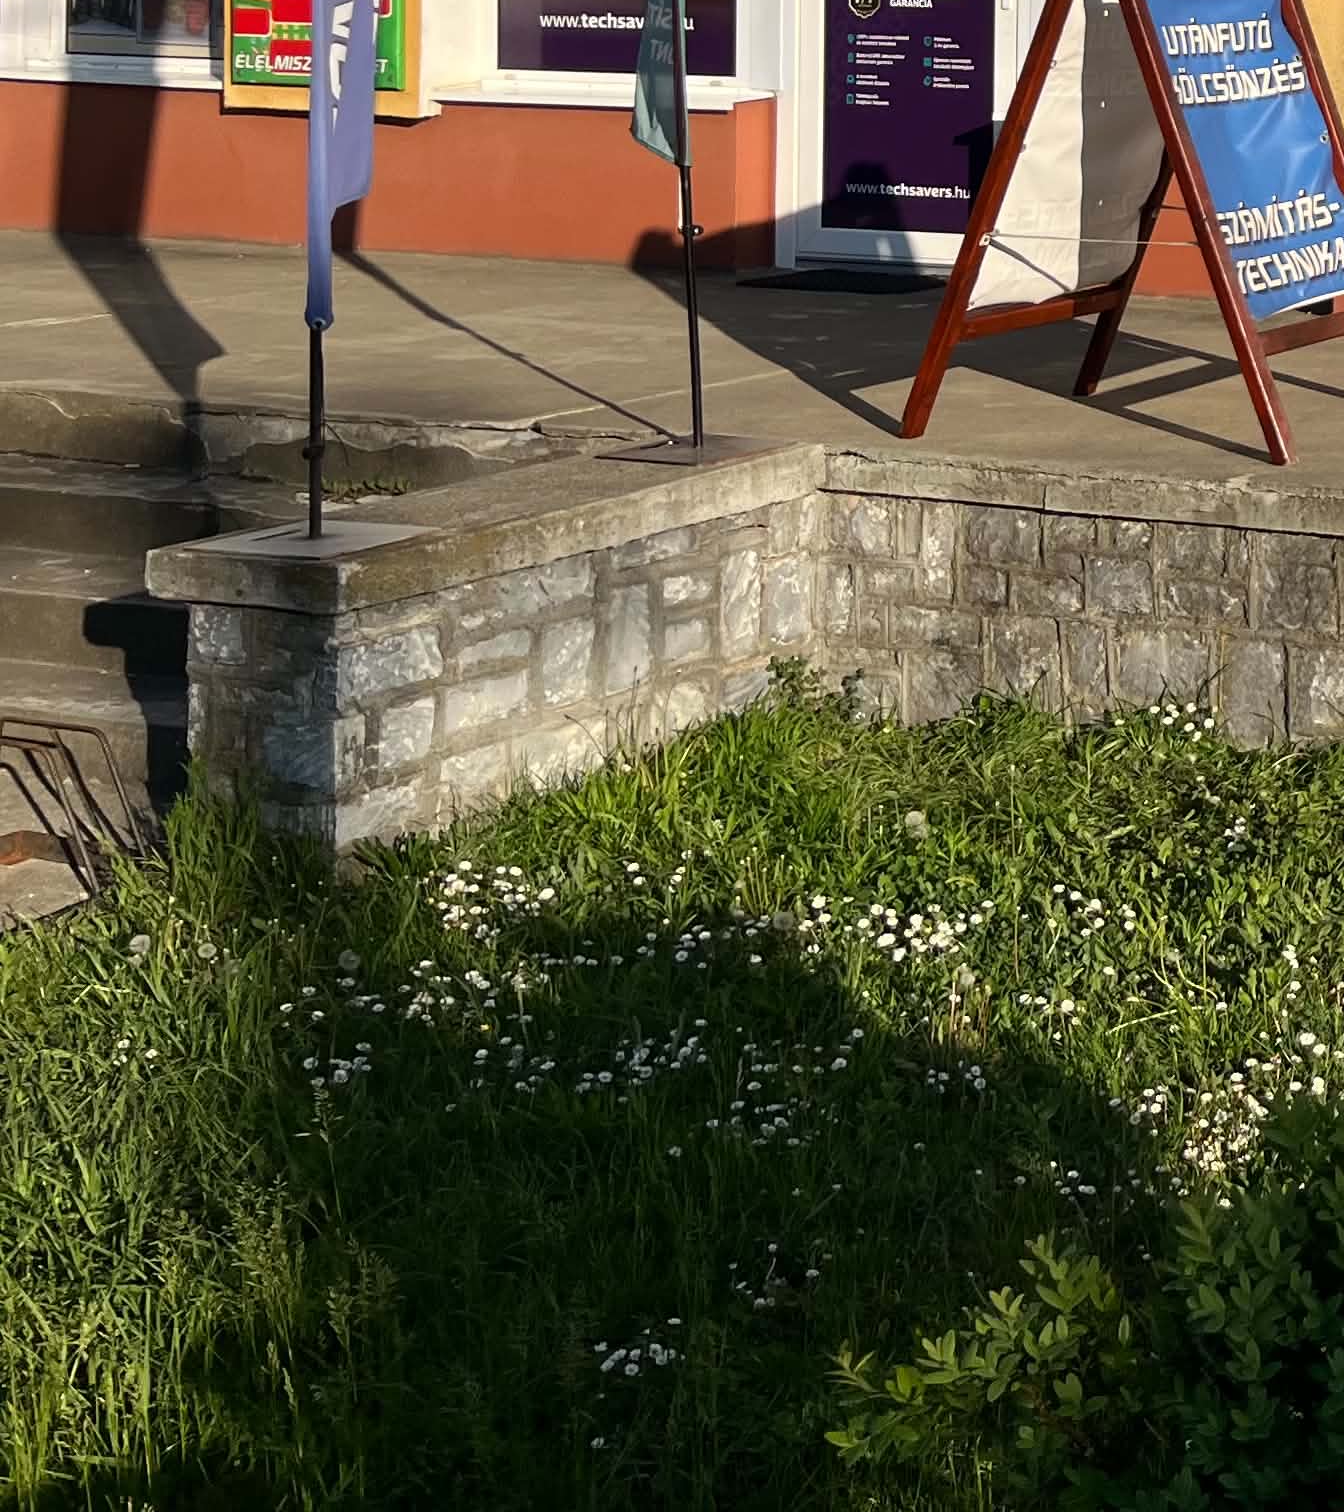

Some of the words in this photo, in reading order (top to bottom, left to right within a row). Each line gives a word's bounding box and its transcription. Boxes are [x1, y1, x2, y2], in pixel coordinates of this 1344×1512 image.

[890, 0, 932, 9] GARANCIA
[540, 12, 694, 31] www.techsavu
[1162, 13, 1272, 55] UTÁNFUTÓ
[846, 183, 971, 199] www.techsavers.hu
[1216, 189, 1340, 245] SZÁMÍTÁS-
